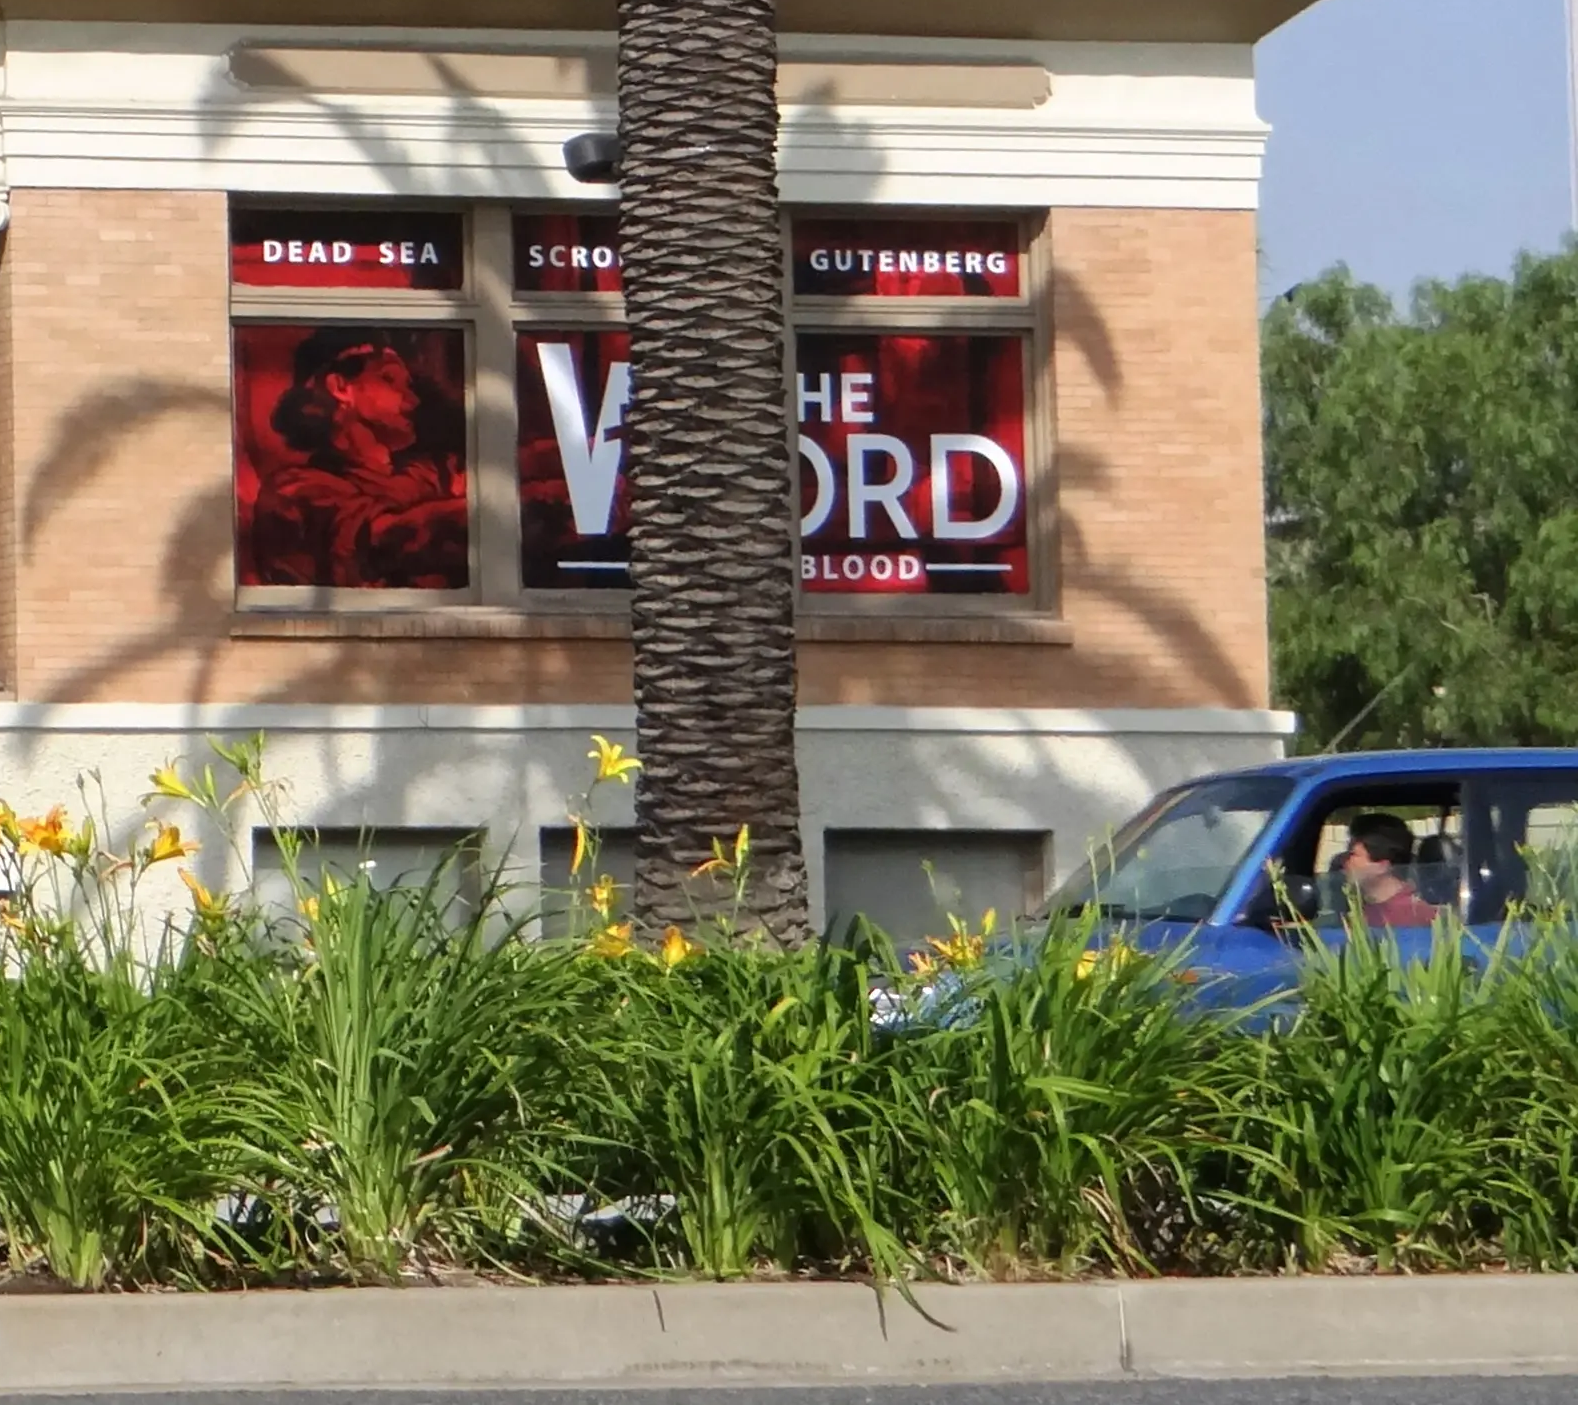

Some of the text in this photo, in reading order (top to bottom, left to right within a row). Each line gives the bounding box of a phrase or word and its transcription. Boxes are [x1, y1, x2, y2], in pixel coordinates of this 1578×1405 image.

[263, 240, 1007, 274] DEAD SEA SCRO GUTENBERG
[796, 373, 875, 423] HE
[800, 554, 921, 581] BLOOD
